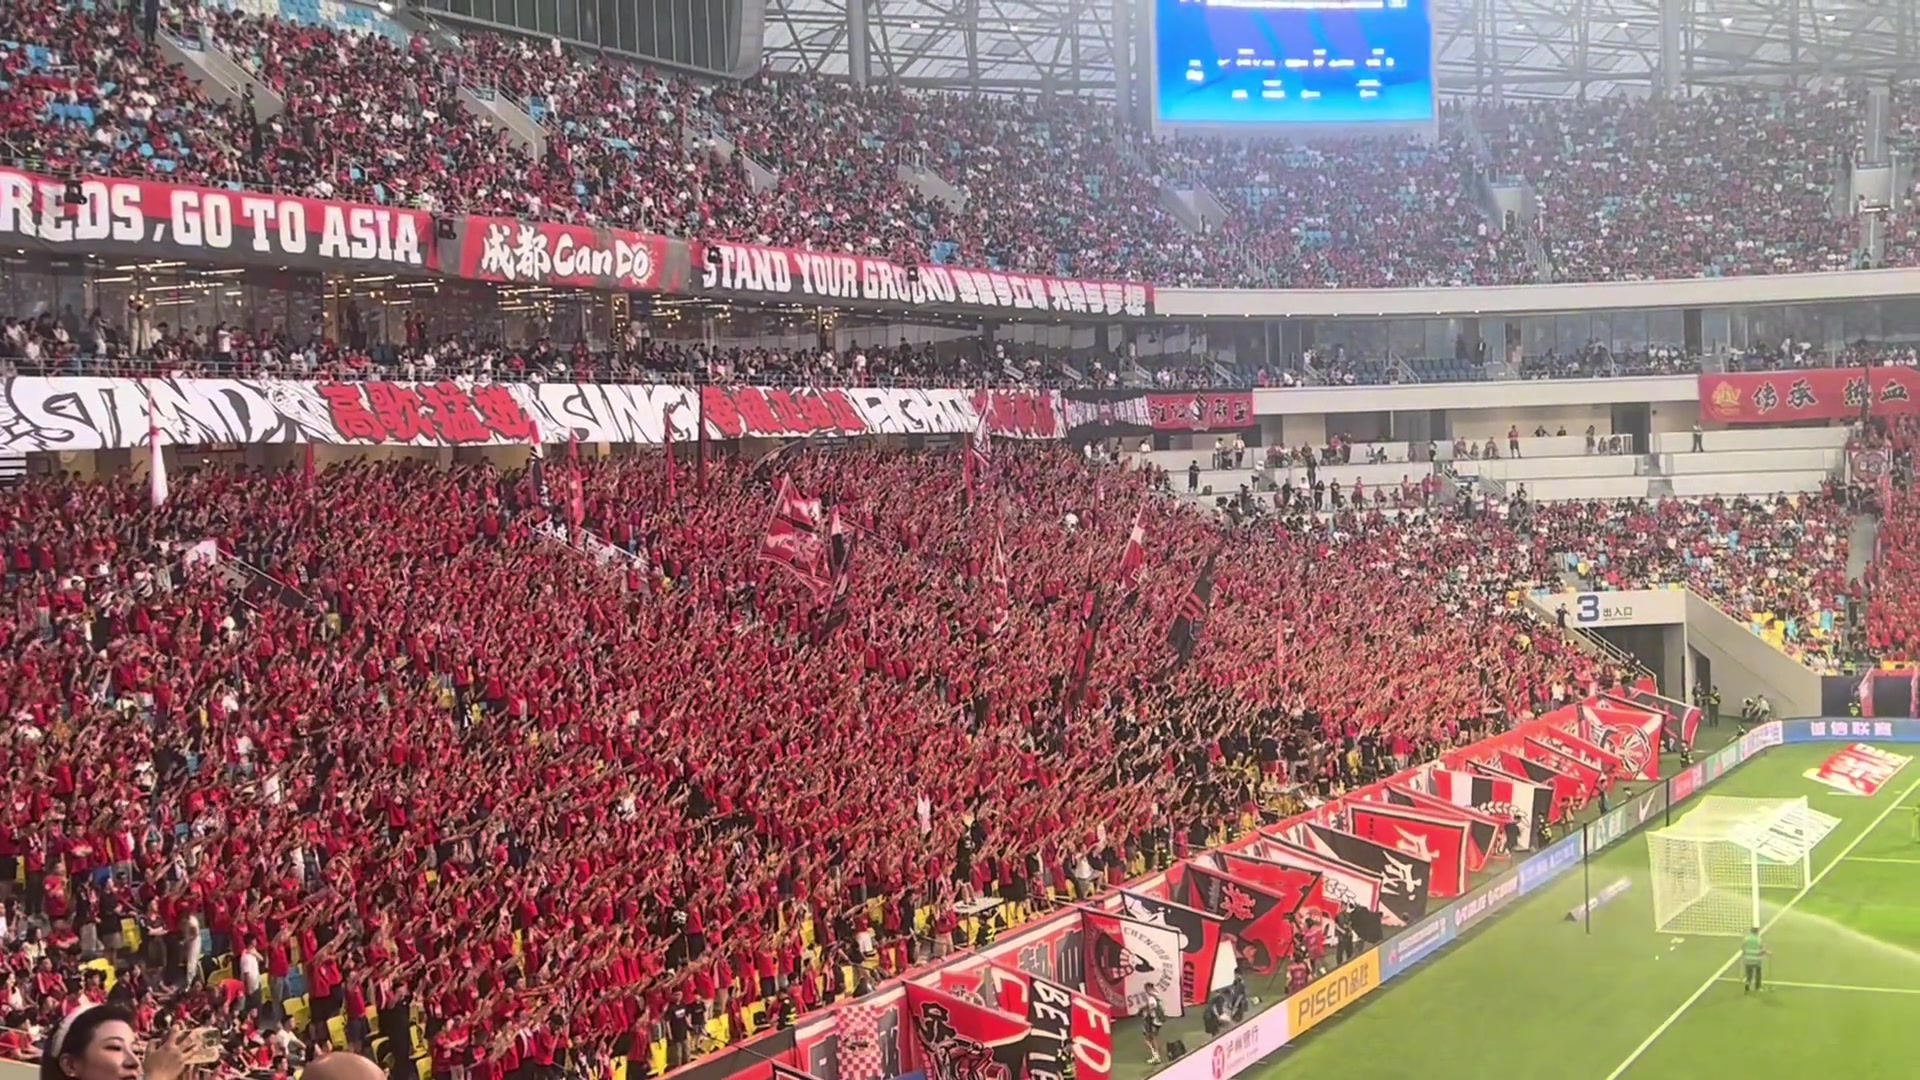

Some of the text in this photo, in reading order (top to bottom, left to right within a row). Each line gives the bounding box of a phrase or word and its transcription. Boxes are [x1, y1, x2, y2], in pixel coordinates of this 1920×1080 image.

[170, 188, 232, 249] GO
[242, 196, 307, 254] TO
[318, 205, 424, 265] ASIA
[481, 223, 551, 282] 成都
[701, 244, 792, 294] STAND
[794, 251, 860, 300] YOUR
[9, 377, 285, 449] STAND
[537, 383, 700, 443] SING
[1577, 594, 1599, 622] 3
[1603, 607, 1632, 617] 出入口
[1297, 974, 1349, 1027] PISEN
